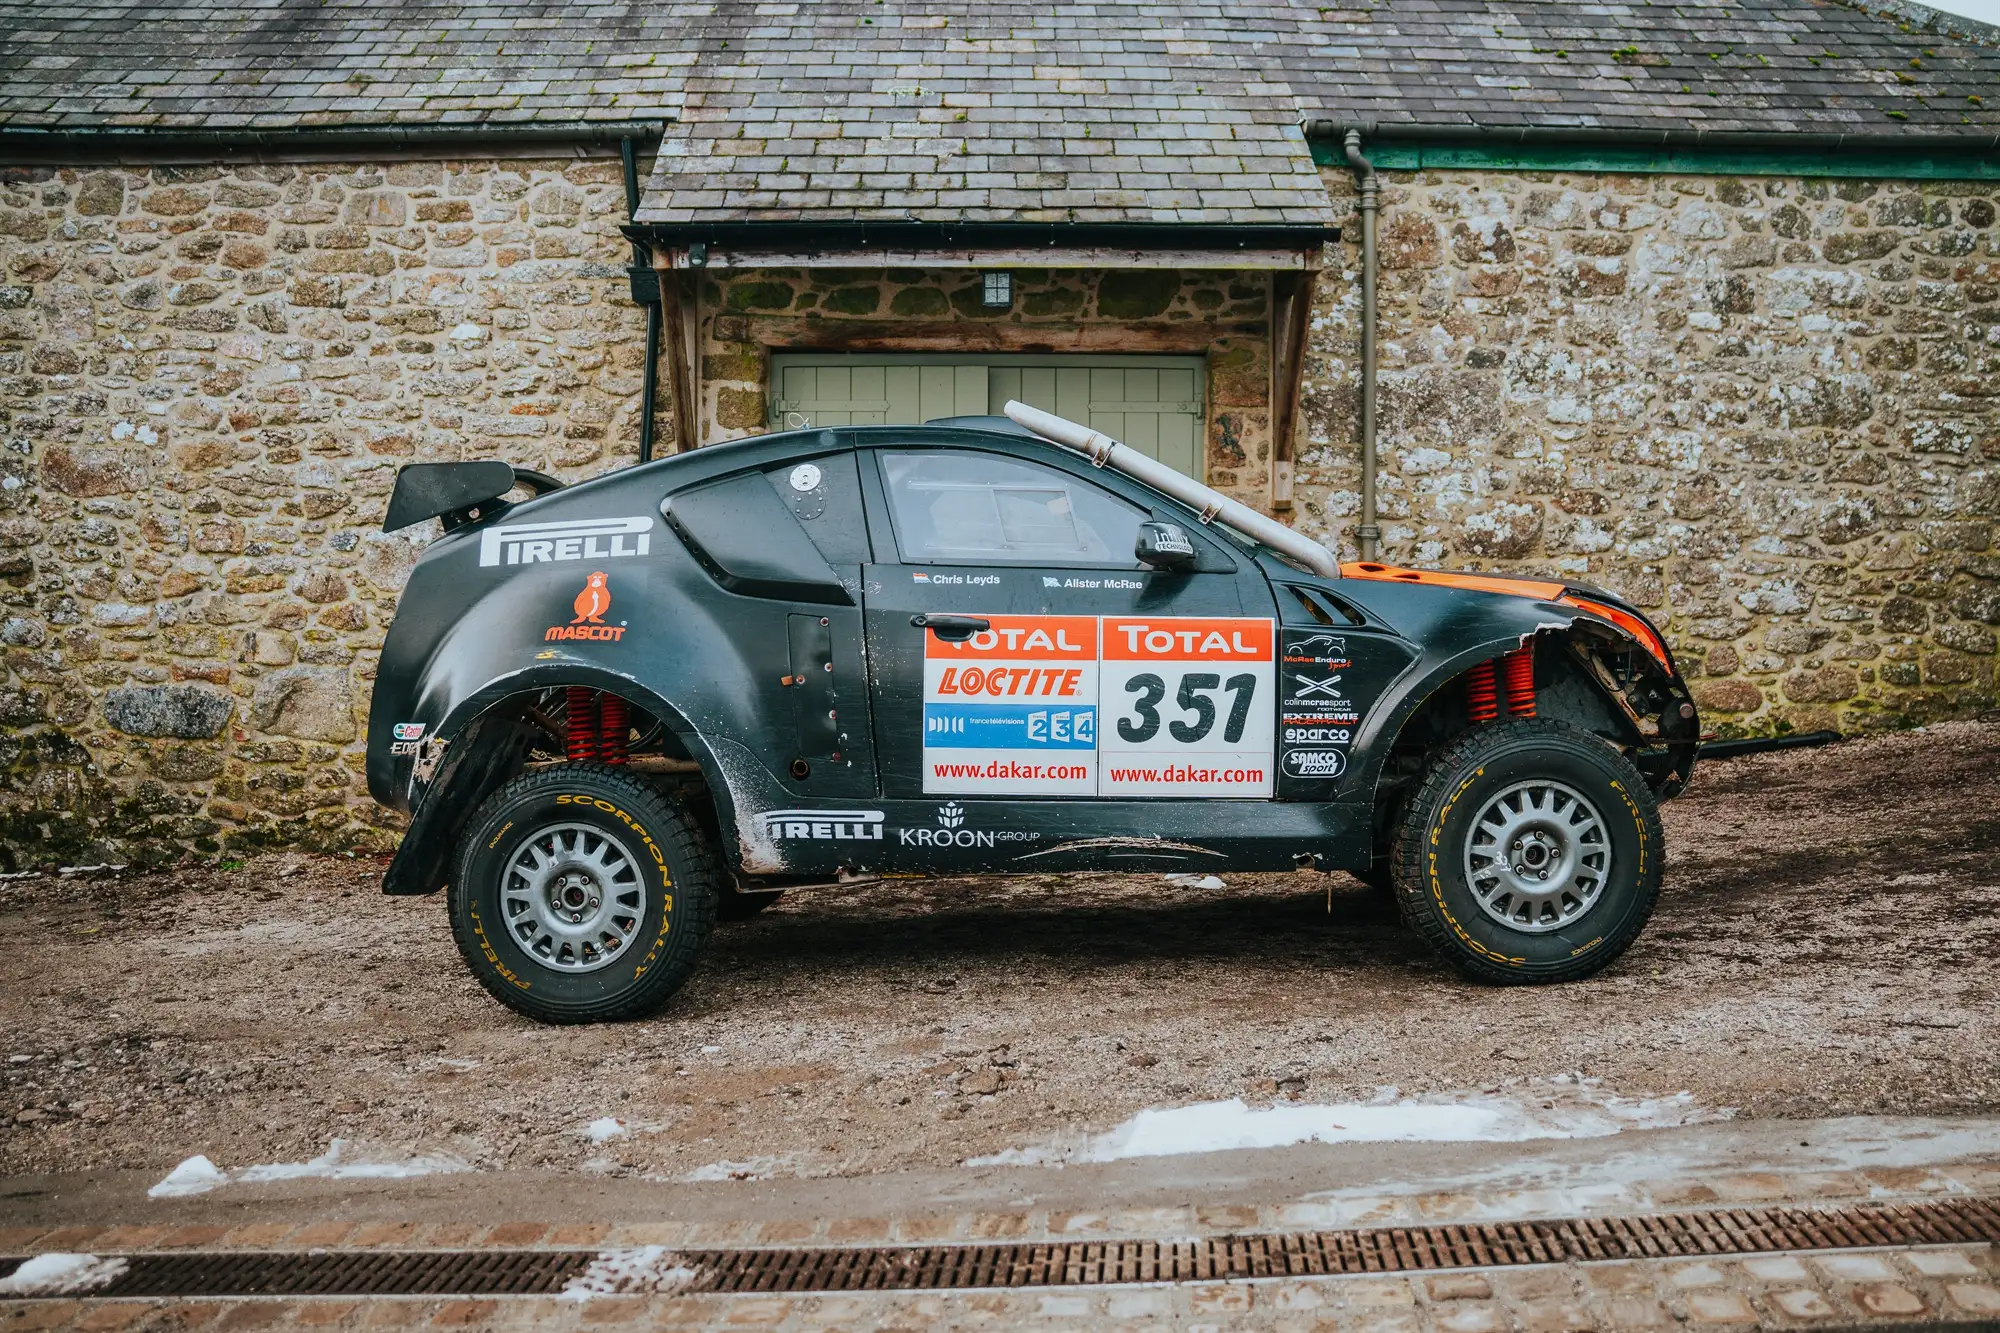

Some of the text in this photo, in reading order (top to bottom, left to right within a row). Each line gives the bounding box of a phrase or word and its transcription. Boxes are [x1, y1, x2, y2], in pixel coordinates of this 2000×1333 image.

[479, 516, 654, 567] PIRELLI
[933, 574, 1000, 586] Chris Leyds
[1063, 578, 1143, 590] Alister McRae
[544, 625, 626, 641] MASCOT
[951, 628, 1081, 652] OTAL
[1117, 625, 1257, 654] TOTAL
[938, 667, 1082, 697] LOCTITE
[1117, 673, 1257, 743] 351
[1283, 712, 1358, 720] EXTREME
[1032, 719, 1047, 737] 2
[1055, 719, 1070, 738] 3
[1077, 719, 1093, 738] 4
[1285, 728, 1349, 744] sparco
[1290, 752, 1336, 765] SAMCO
[1302, 762, 1334, 773] sport
[934, 760, 1087, 779] www.dakar.com
[1111, 764, 1263, 783] www.dakar.com
[900, 828, 1041, 848] KROON GROUP
[556, 794, 673, 980] SCORPION RALLY
[471, 911, 533, 990] PIRELLI
